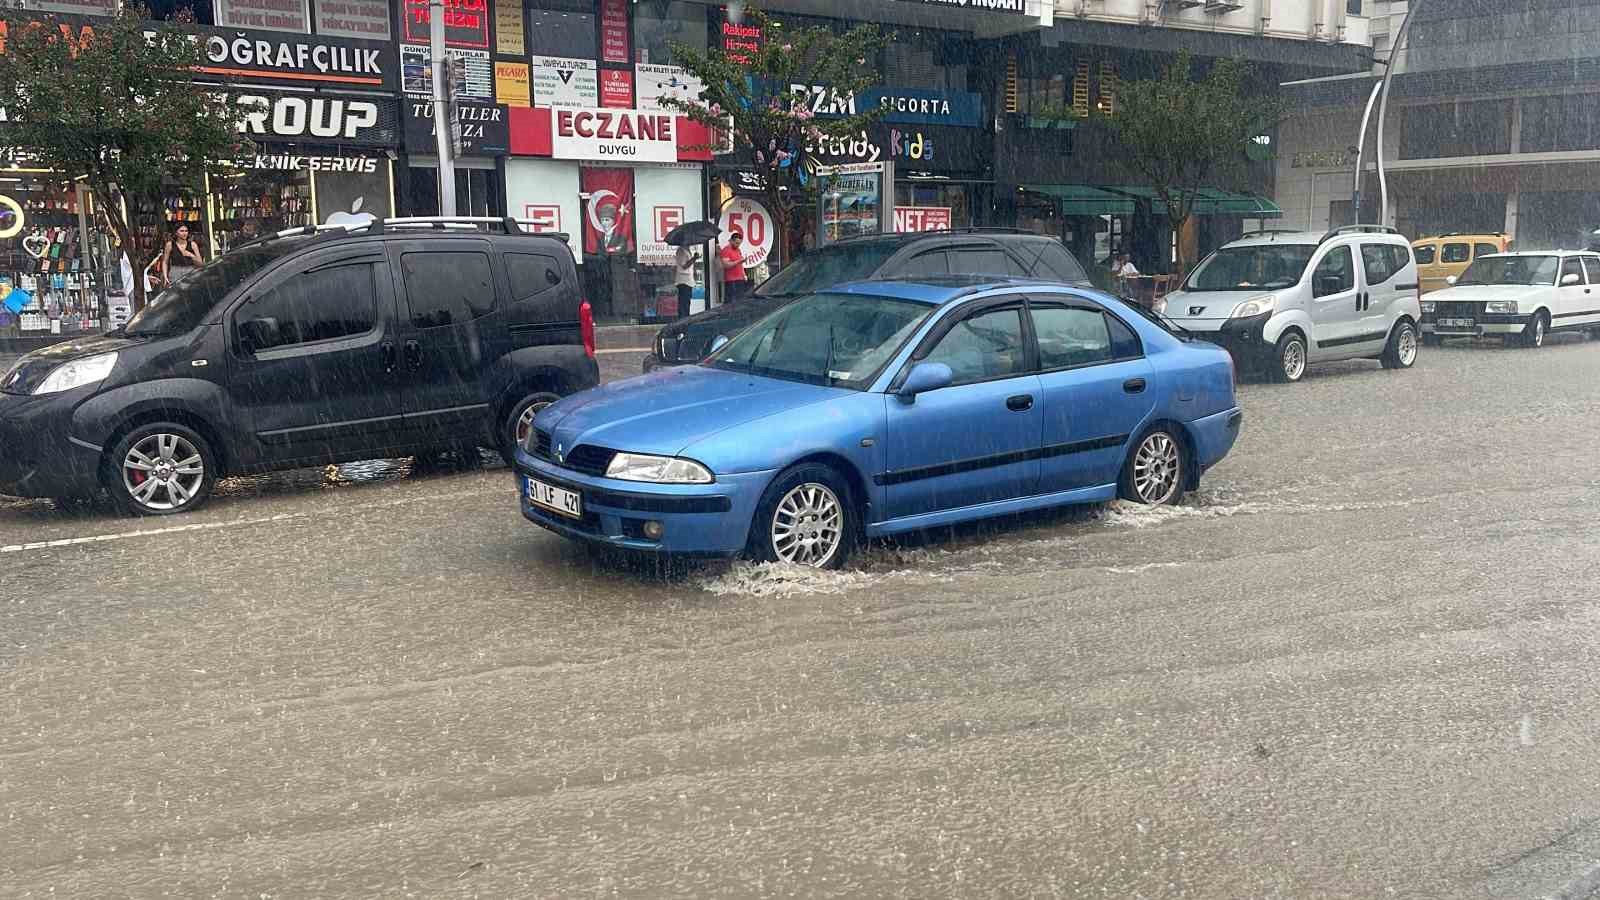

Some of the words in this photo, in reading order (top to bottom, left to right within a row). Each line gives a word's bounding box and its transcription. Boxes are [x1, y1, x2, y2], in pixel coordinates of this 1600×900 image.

[557, 110, 672, 142] ECZANE
[599, 144, 637, 156] DUYGU
[890, 128, 934, 160] Kids
[309, 154, 379, 173] SERVİS
[894, 209, 925, 233] NET
[529, 481, 538, 499] 61
[543, 486, 554, 504] LF
[564, 492, 579, 512] 421
